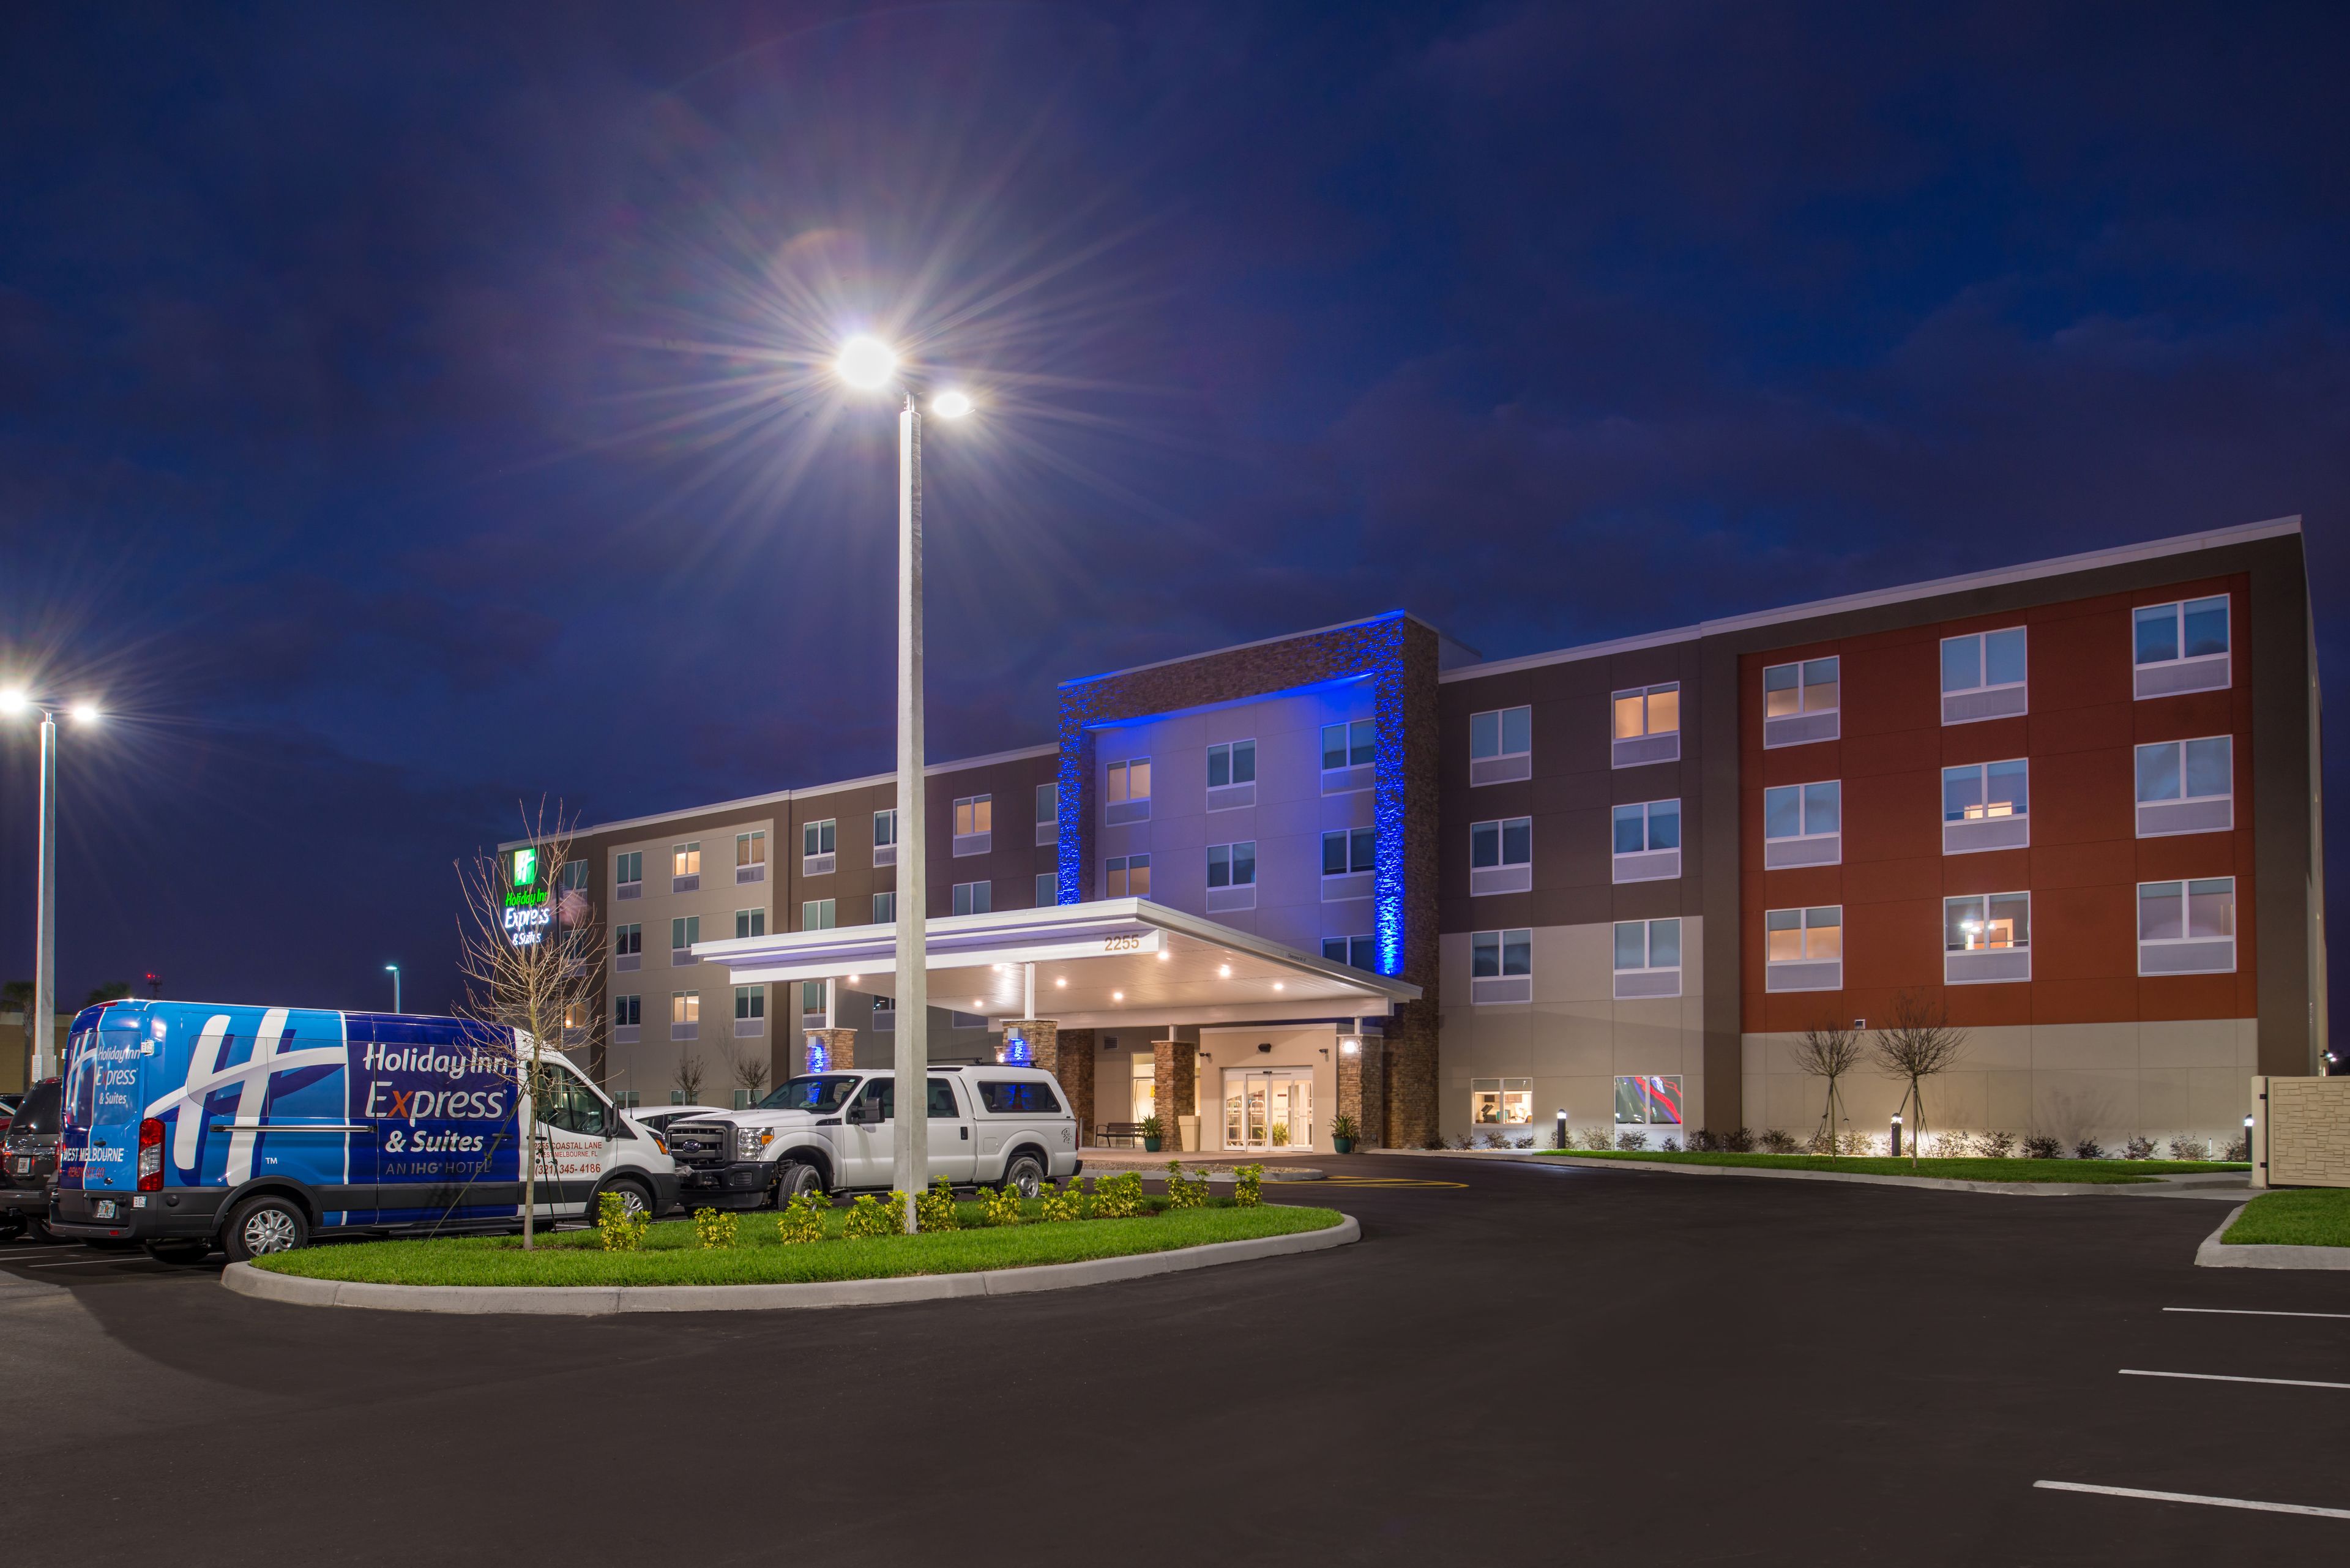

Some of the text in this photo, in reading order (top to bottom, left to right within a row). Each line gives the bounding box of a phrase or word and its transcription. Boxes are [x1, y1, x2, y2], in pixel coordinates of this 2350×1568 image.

[505, 890, 535, 906] Holiday
[513, 933, 518, 946] &
[1105, 934, 1139, 951] 2255
[98, 1045, 141, 1064] Holiday Inn
[363, 1043, 507, 1080] Holiday Inn
[97, 1066, 136, 1091] Express
[99, 1092, 127, 1104] & Suites
[365, 1081, 504, 1127] Express
[385, 1130, 484, 1153] & Suites
[534, 1142, 549, 1151] 2255
[63, 1148, 124, 1162] WEST MELBOURNE
[386, 1162, 490, 1174] AN IHG HOTEL
[535, 1165, 556, 1176] (321)
[580, 1163, 600, 1173] 4186
